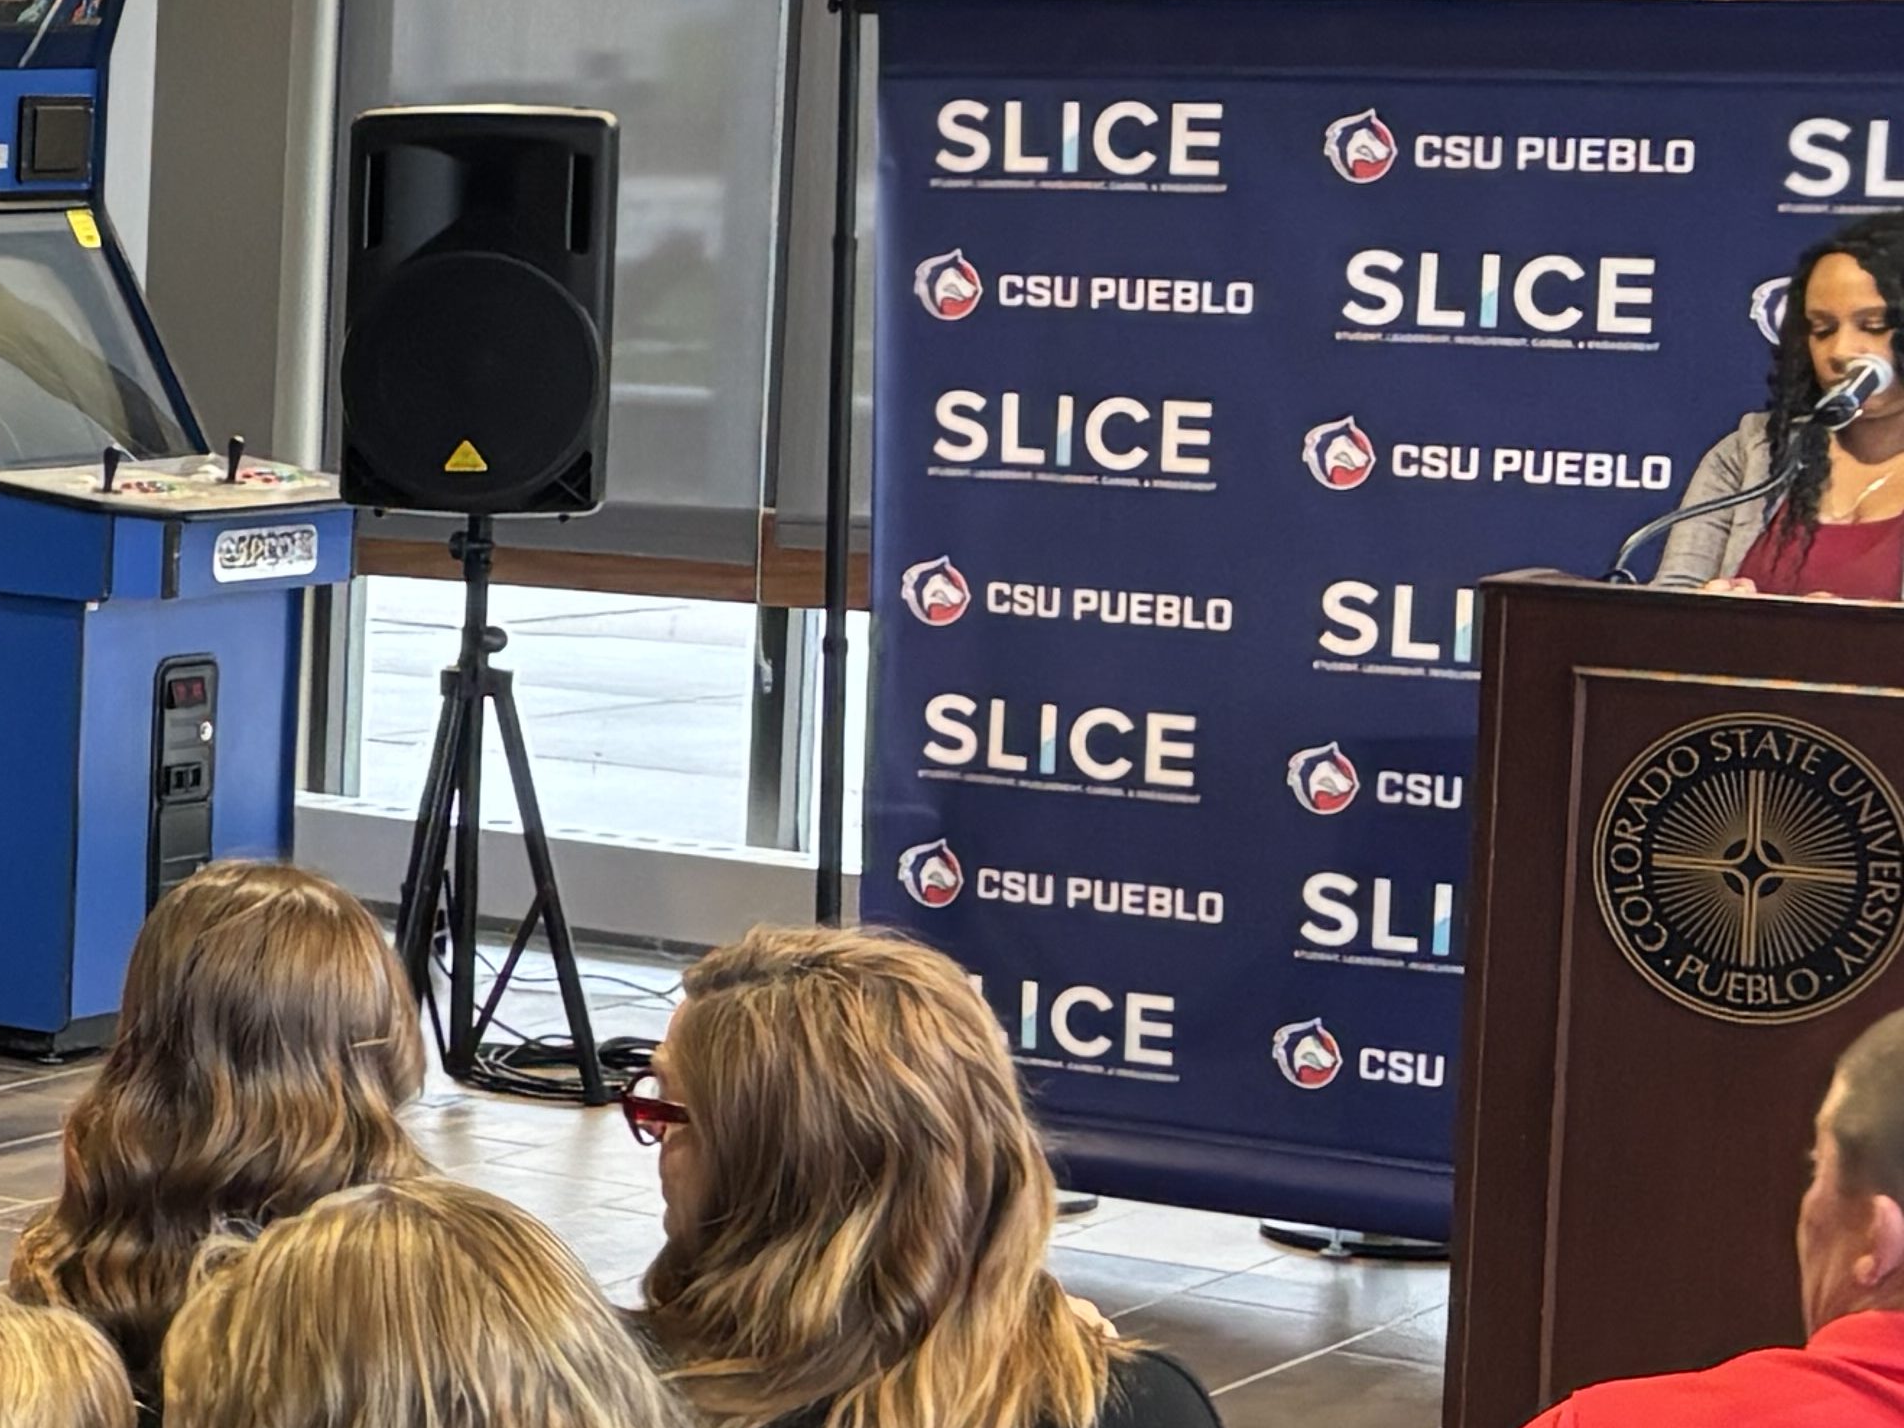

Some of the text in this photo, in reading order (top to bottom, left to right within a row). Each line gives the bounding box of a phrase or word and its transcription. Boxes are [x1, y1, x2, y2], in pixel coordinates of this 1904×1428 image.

[935, 99, 1224, 176] SLICE
[1414, 134, 1696, 174] CSU PUEBLO
[998, 274, 1254, 315] CSU PUEBLO
[1341, 249, 1656, 334] SLICE
[932, 389, 1213, 475] SLICE
[1391, 443, 1672, 490] CSU PUEBLO
[986, 581, 1233, 632] CSU PUEBLO
[1318, 580, 1475, 663] SLI
[922, 693, 1198, 788] SLICE
[1376, 771, 1463, 809] CSU
[1609, 727, 1903, 977] COLORADO STATE UNIVERSITY
[976, 868, 1224, 924] CSU PUEBLO
[1299, 872, 1454, 958] SLI
[1674, 953, 1821, 1007] PUEBLO
[968, 974, 1176, 1067] ICE
[1359, 1047, 1445, 1088] CSU
